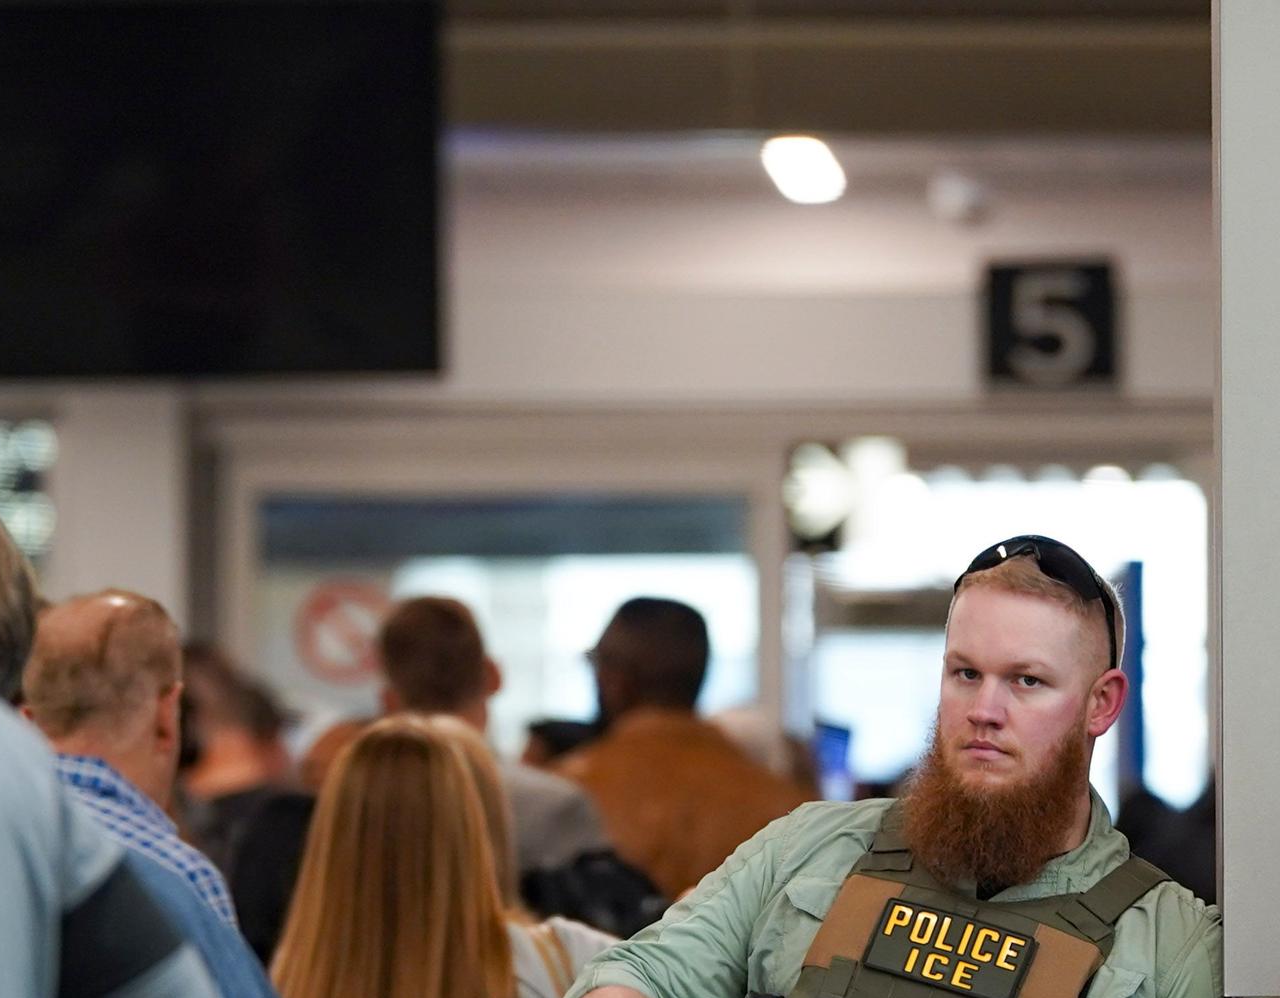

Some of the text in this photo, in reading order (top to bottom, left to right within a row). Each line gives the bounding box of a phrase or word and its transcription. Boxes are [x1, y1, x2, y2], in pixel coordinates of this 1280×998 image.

[1007, 268, 1099, 386] 5
[883, 903, 1026, 971] POLICE
[903, 948, 980, 989] ICE
